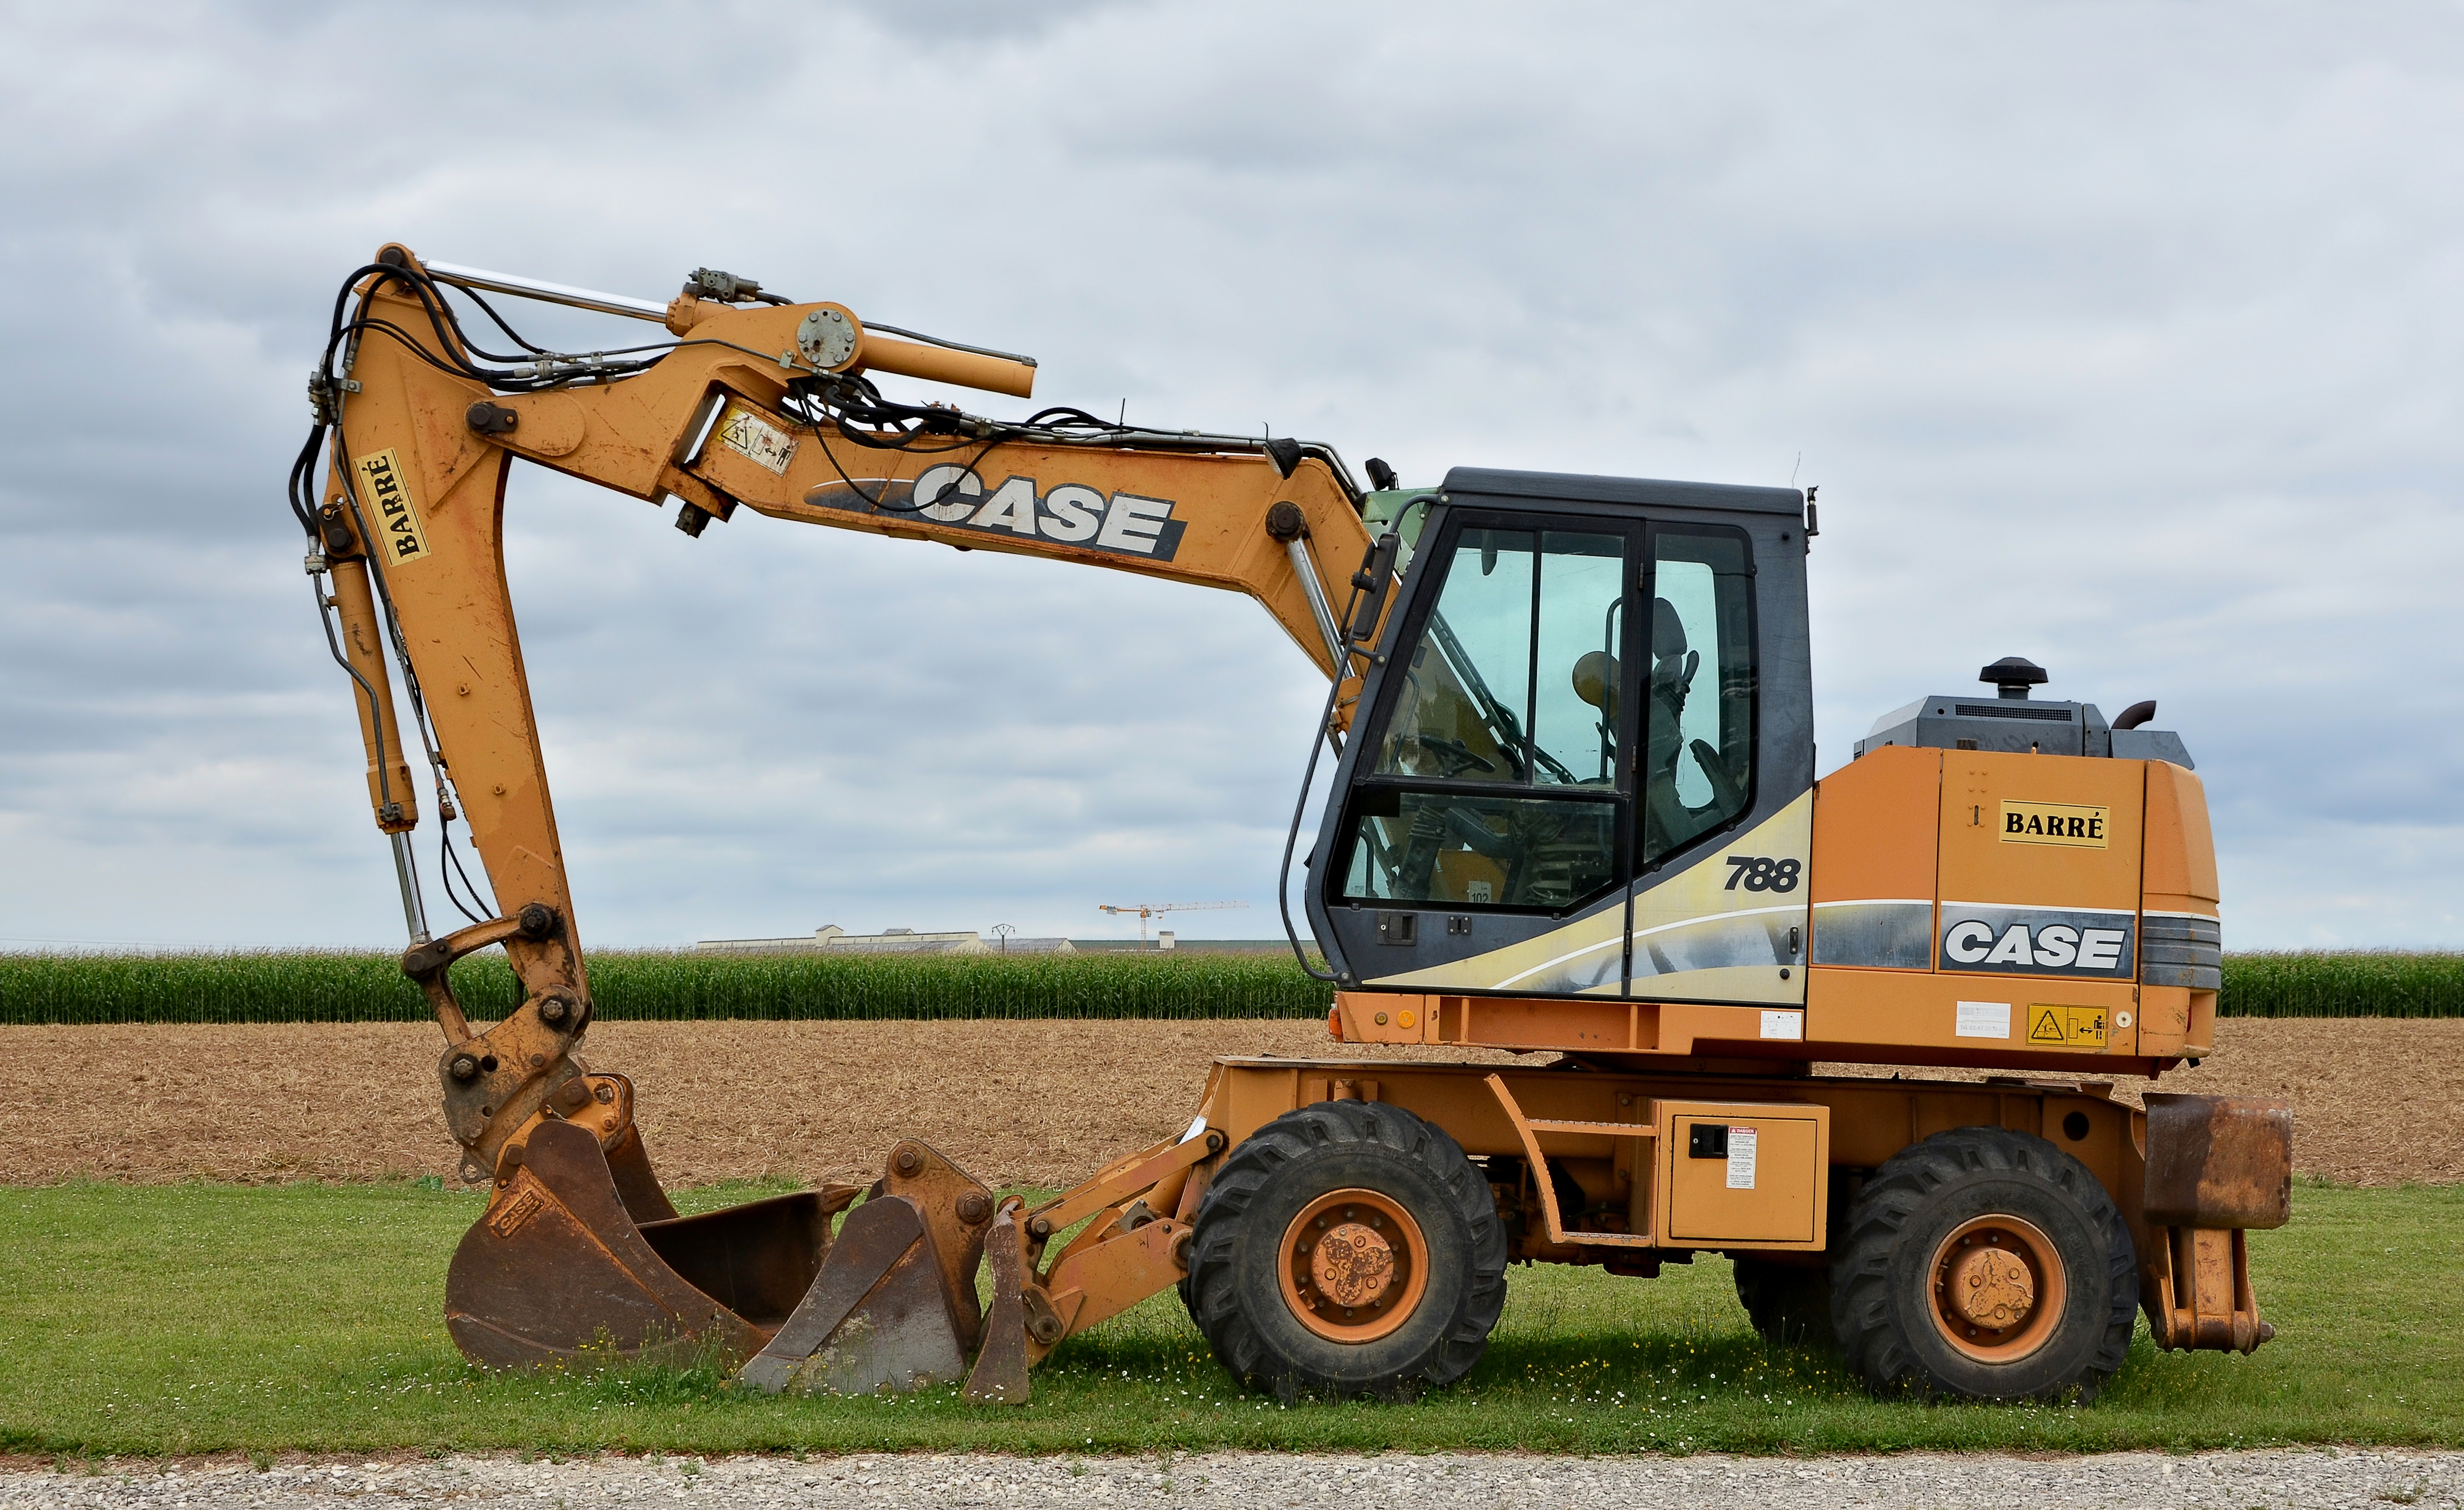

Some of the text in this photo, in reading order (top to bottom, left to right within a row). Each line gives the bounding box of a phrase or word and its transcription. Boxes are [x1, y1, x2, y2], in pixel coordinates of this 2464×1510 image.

[362, 455, 420, 557] BARRÉ
[914, 466, 1171, 554] CASE
[2005, 812, 2104, 839] BARRÉ
[1724, 856, 1801, 893] 788
[1472, 892, 1489, 903] 102
[1946, 921, 2125, 969] CASE
[500, 1193, 534, 1229] CASE
